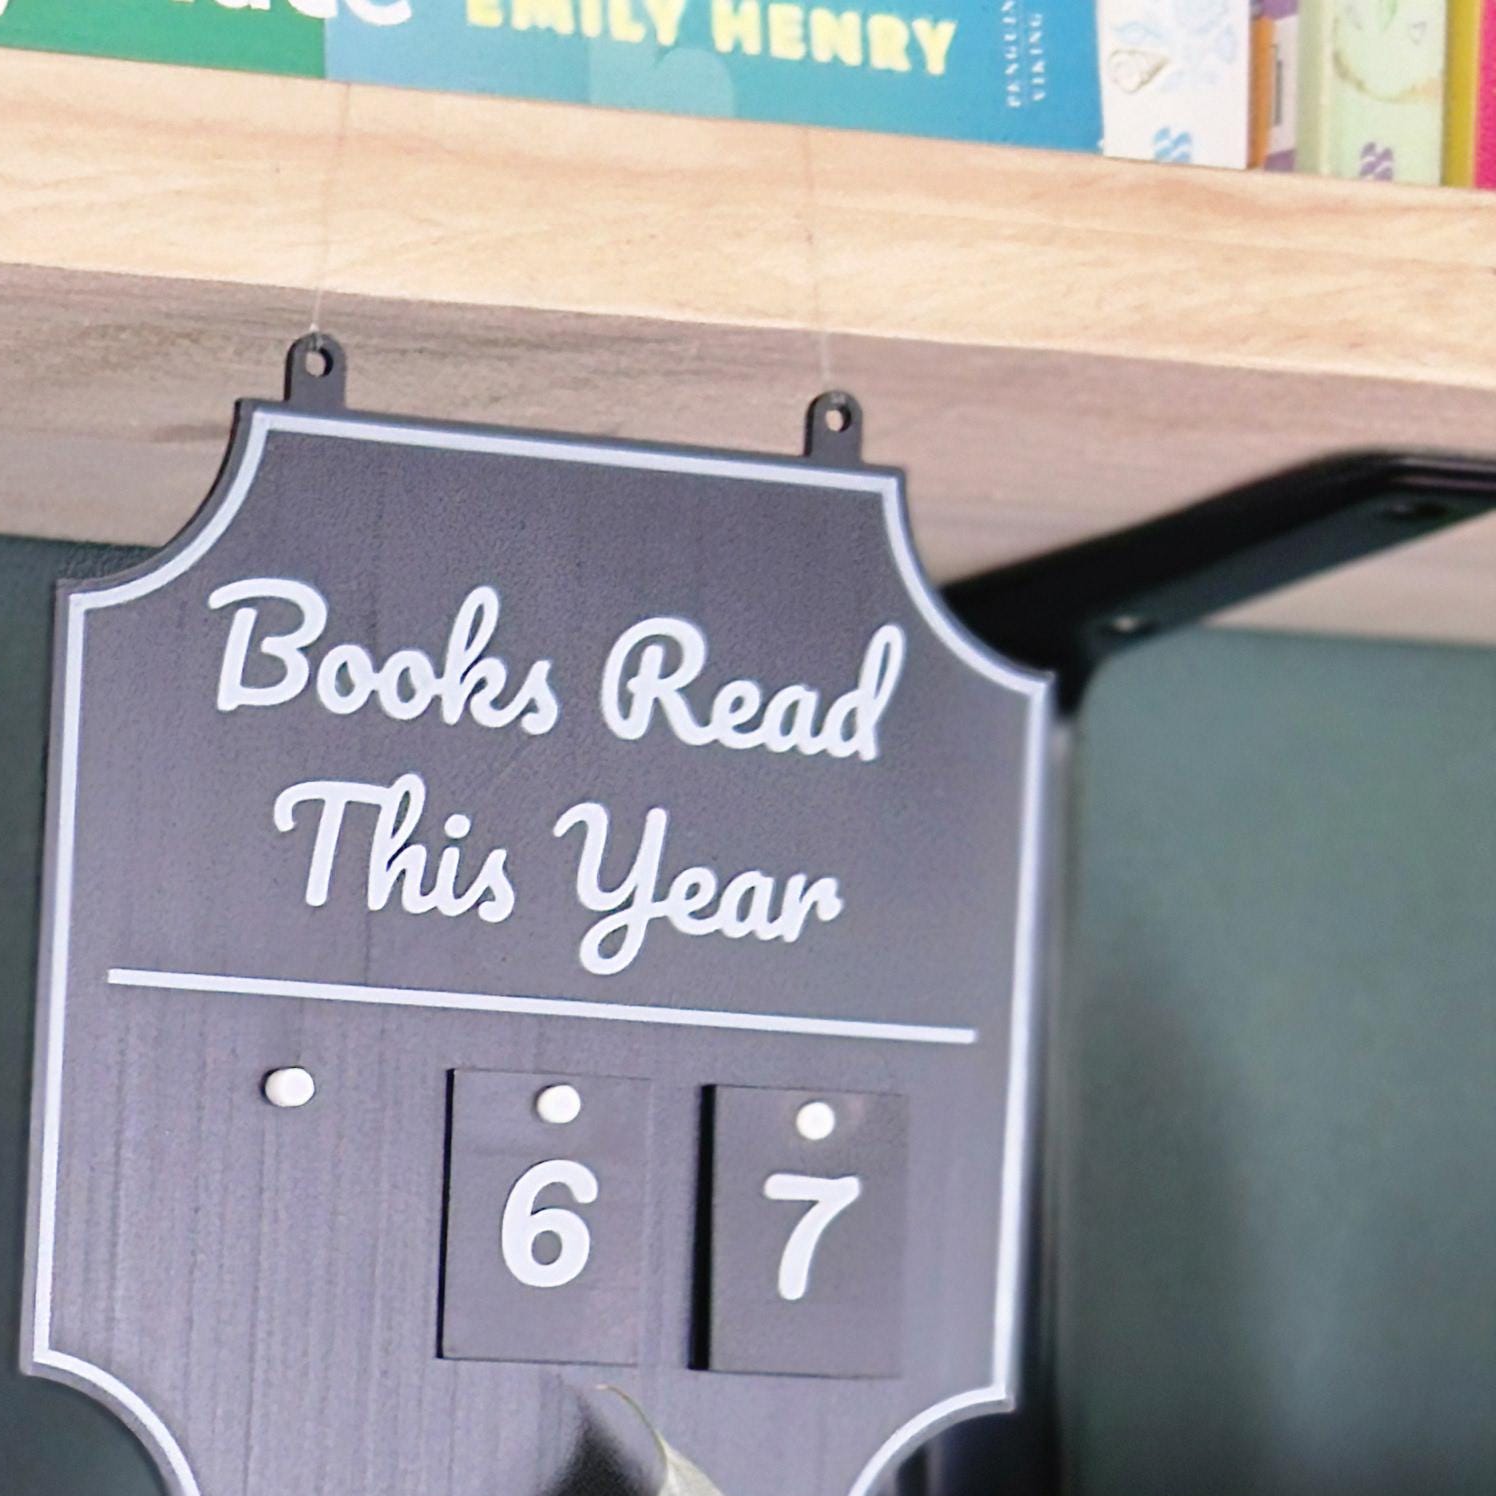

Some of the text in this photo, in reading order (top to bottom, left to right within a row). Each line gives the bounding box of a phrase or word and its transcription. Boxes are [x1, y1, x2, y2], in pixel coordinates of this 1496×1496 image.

[710, 0, 957, 76] HENRY
[206, 576, 906, 763] Books Read
[271, 772, 845, 977] This Year
[500, 1158, 863, 1302] 6 7
